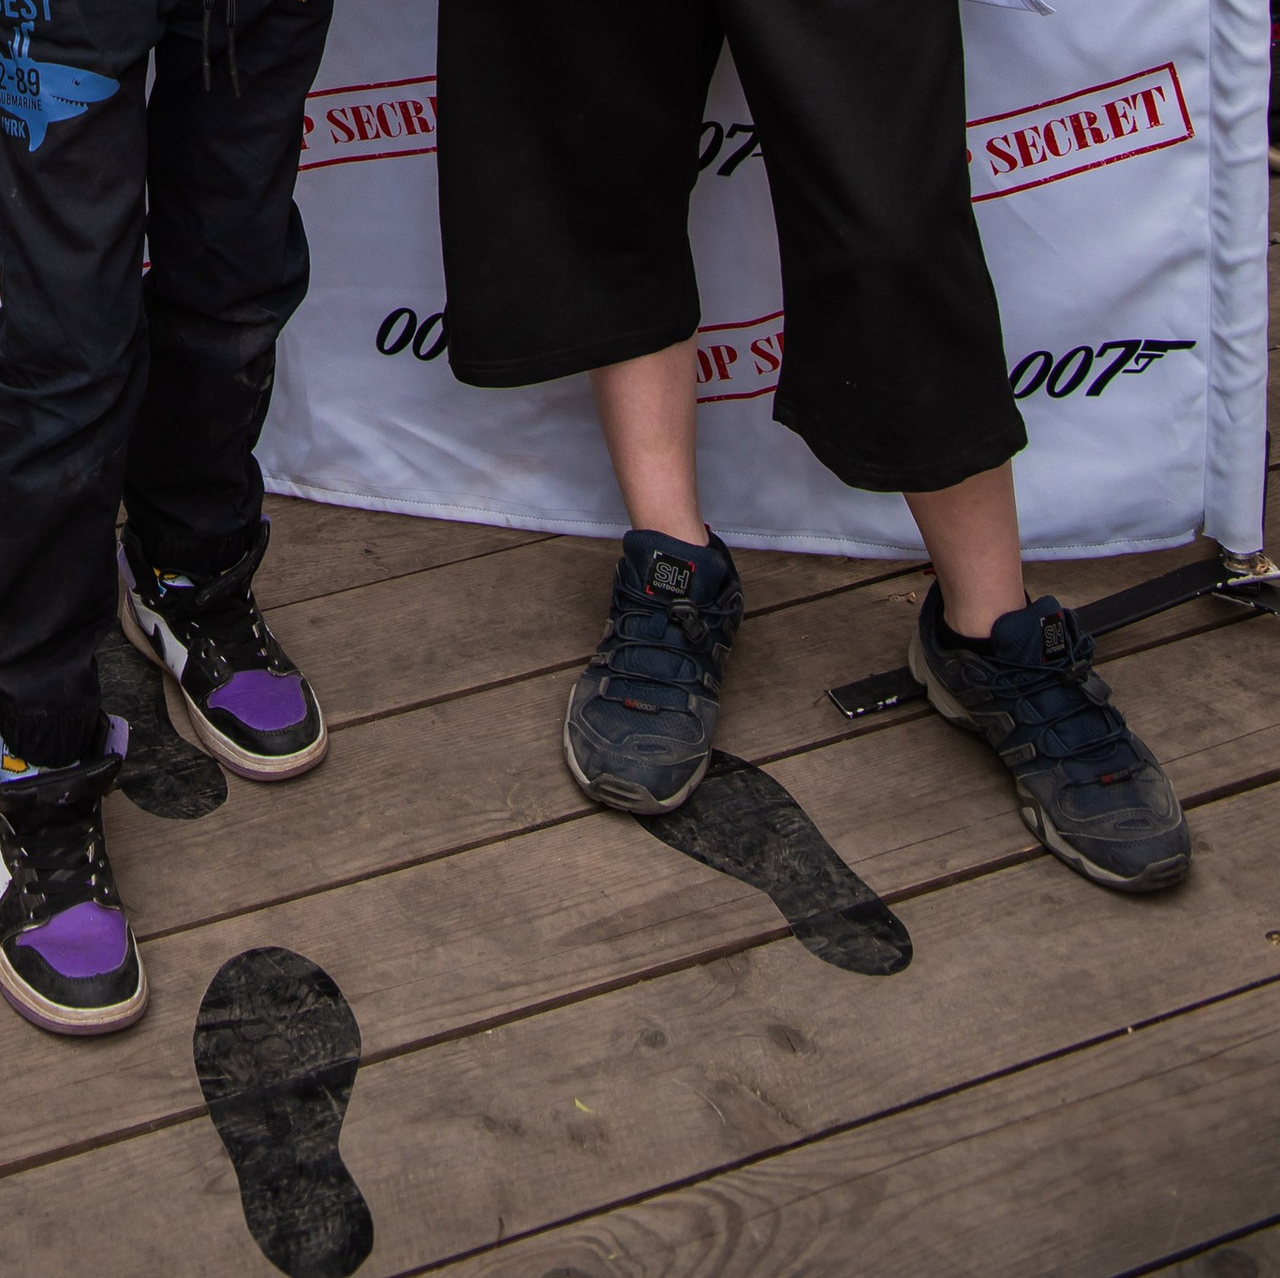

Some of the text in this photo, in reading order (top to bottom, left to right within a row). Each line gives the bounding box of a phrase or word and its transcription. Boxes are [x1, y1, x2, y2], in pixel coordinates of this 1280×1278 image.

[326, 96, 438, 144] SECR
[986, 86, 1166, 176] SECRET
[698, 121, 759, 177] 07
[376, 307, 448, 362] 00
[696, 344, 739, 384] OP
[1009, 339, 1143, 400] 007
